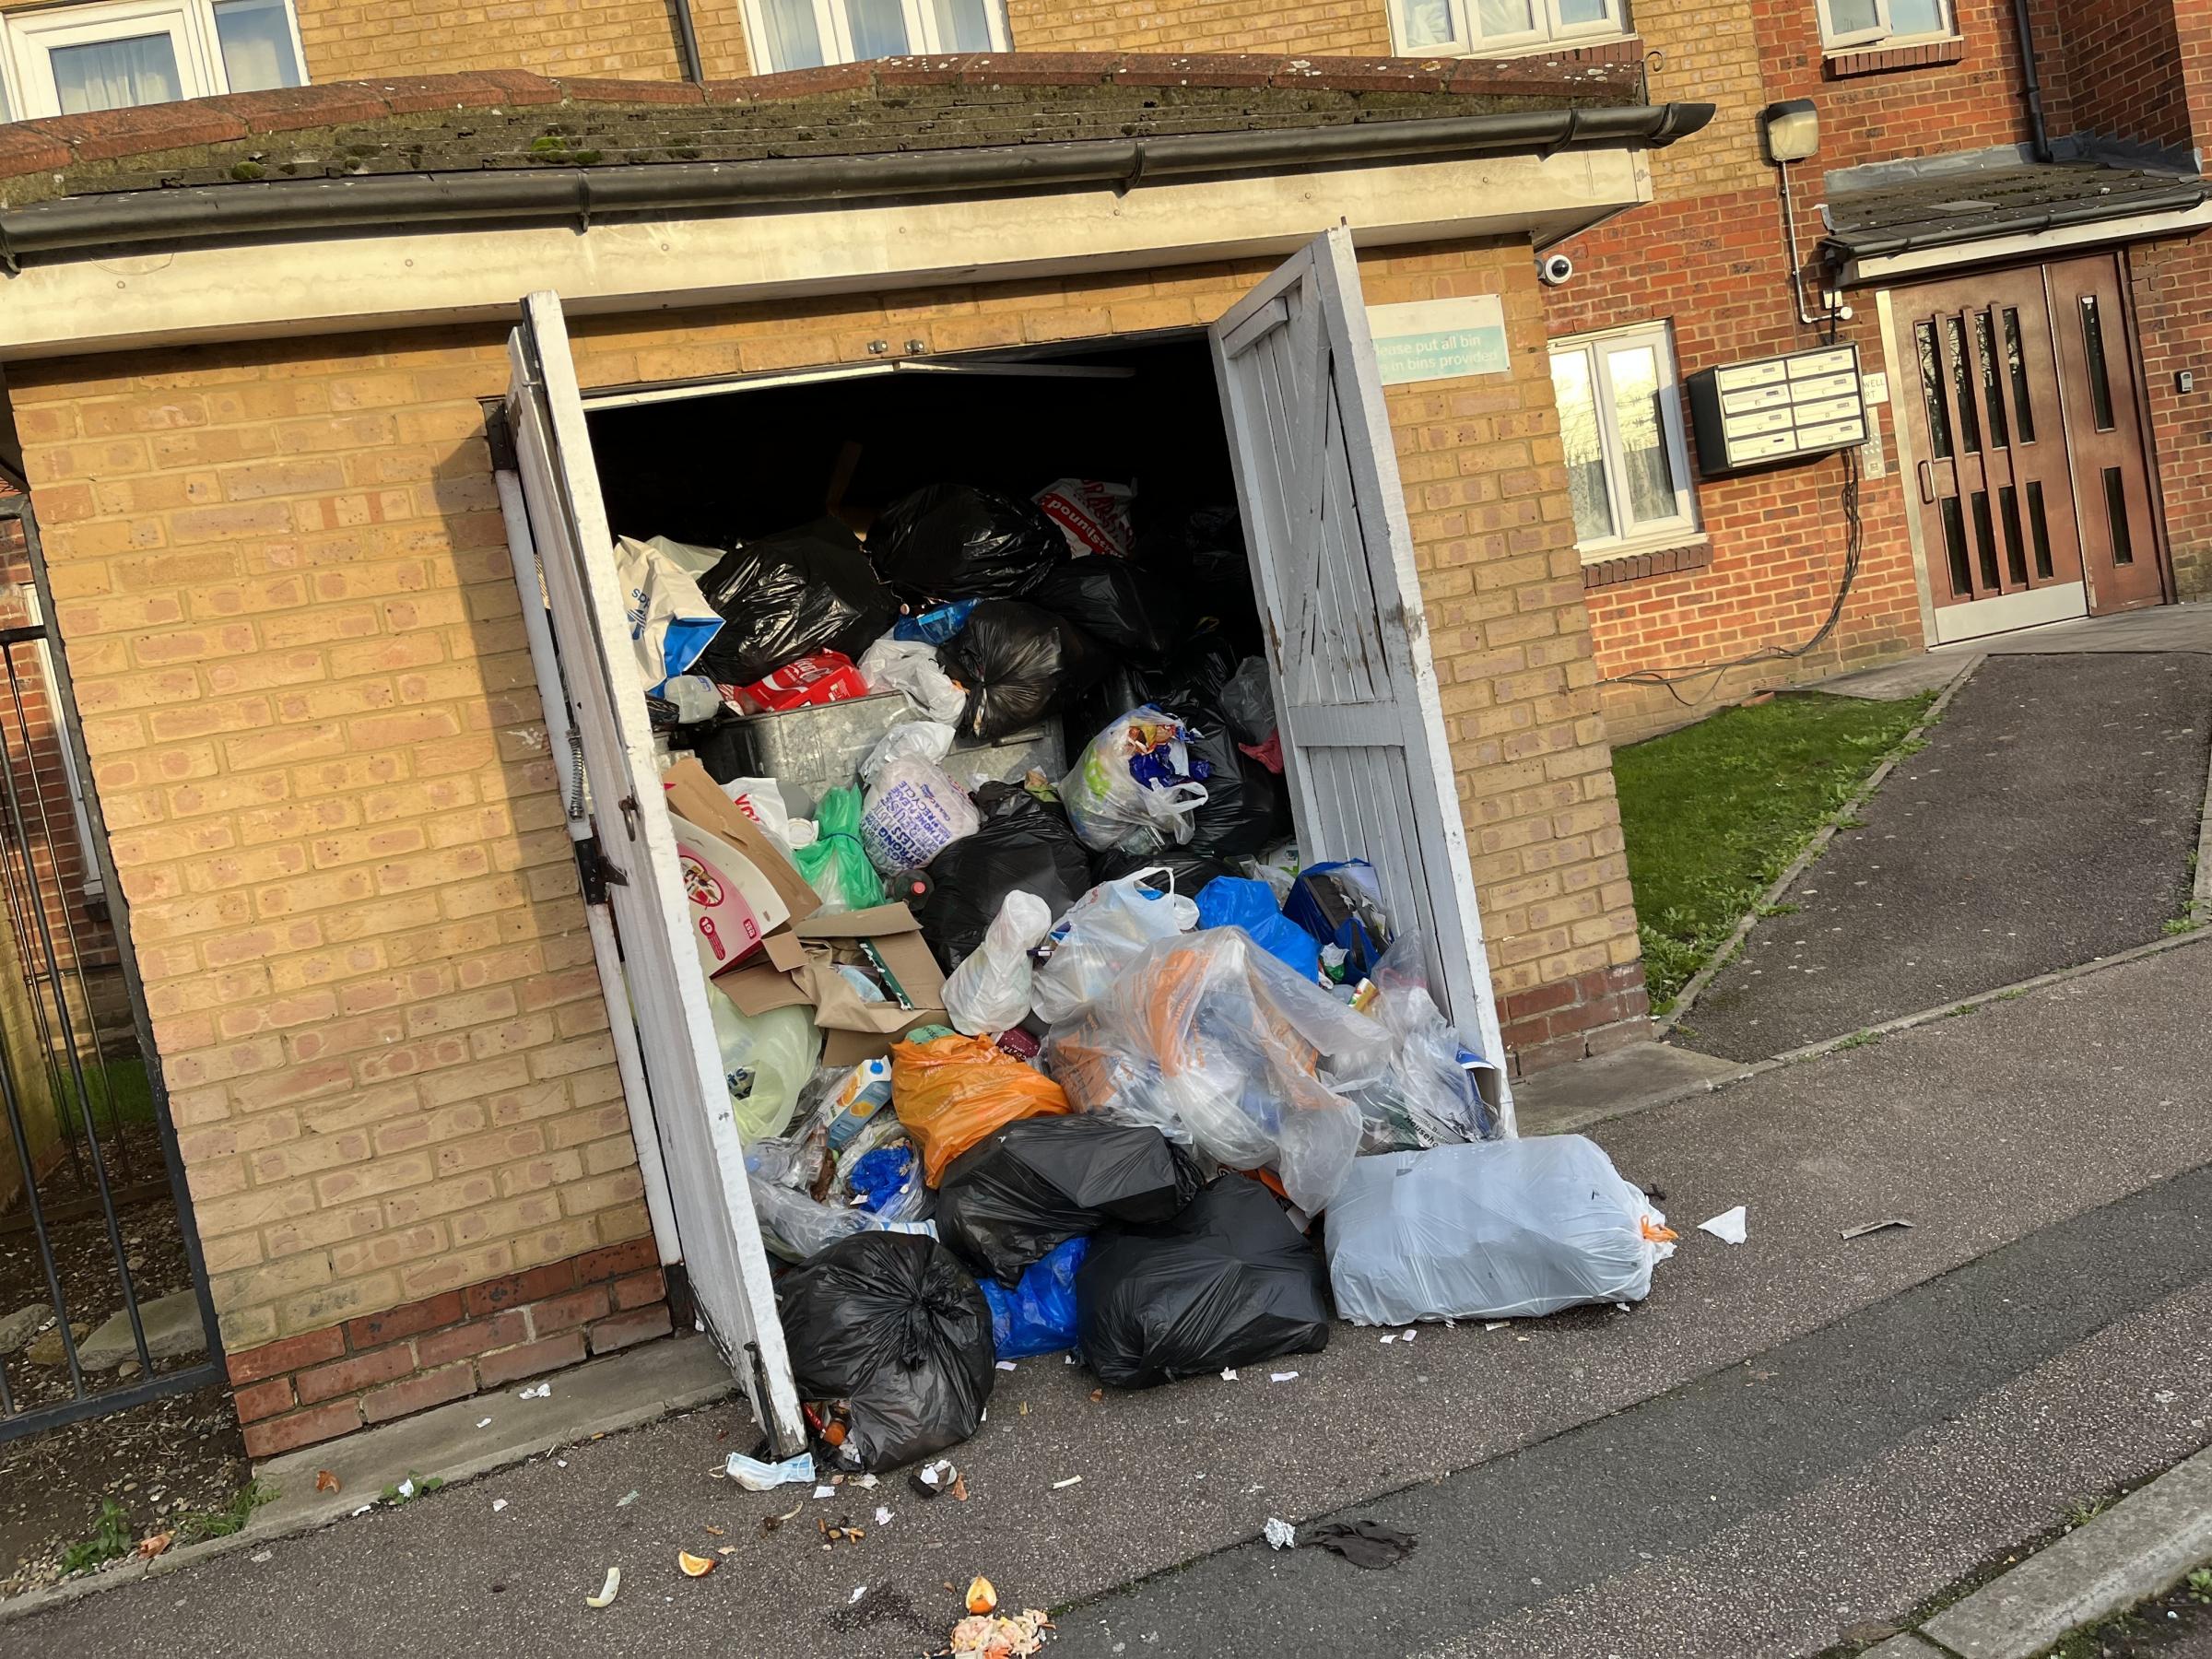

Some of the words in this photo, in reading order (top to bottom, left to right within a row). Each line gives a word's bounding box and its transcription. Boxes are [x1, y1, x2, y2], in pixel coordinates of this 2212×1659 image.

[1374, 342, 1412, 356] lease
[1416, 338, 1441, 356] put
[1441, 335, 1457, 350] all
[1460, 333, 1481, 347] bin
[1392, 359, 1405, 371] in
[1407, 356, 1436, 371] bins
[1439, 347, 1498, 371] provided
[1863, 378, 1886, 389] WELL
[1865, 390, 1876, 399] RT
[877, 826, 923, 866] STRONG
[700, 917, 713, 934] 19
[1404, 1115, 1439, 1148] Househo
